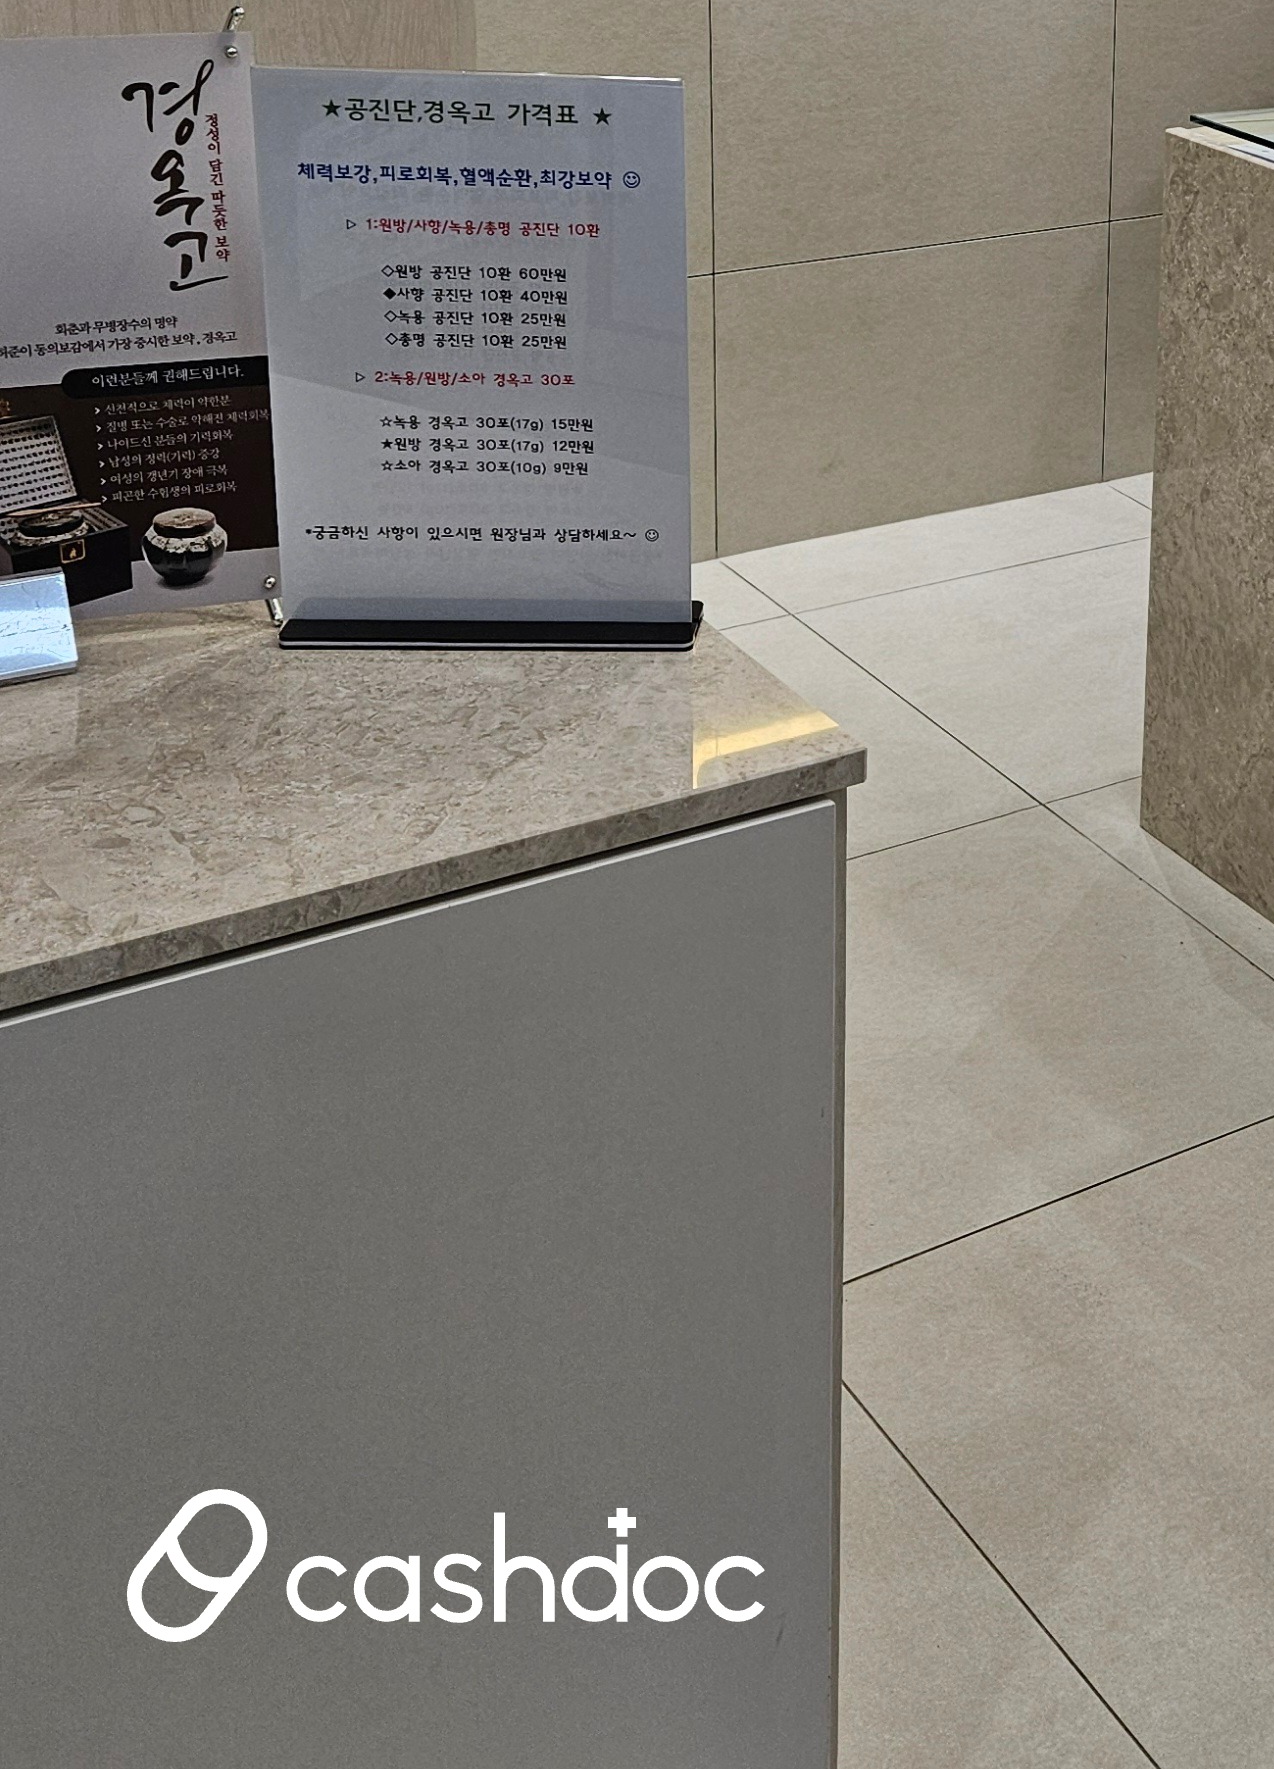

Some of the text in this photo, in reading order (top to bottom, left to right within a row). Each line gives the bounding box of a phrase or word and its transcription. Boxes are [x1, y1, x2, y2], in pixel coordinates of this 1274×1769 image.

[344, 98, 579, 127] 공진단,경옥고 가격표
[205, 113, 221, 155] 정성이
[121, 58, 229, 292] 경옥고
[209, 158, 224, 187] 담긴
[297, 161, 613, 190] 체력보강,피로회복,혈액순환,최강보약
[519, 221, 561, 238] 공진단
[568, 223, 601, 239] 10환
[215, 235, 230, 262] 보약
[394, 264, 567, 283] 원방 공진단 10환 60만원
[397, 287, 568, 305] 사향 공진단 10환 40만원
[154, 315, 178, 329] 명약
[397, 310, 567, 328] 녹용 공진단 10환 25만원
[34, 339, 107, 357] 동의보감에서
[108, 338, 132, 352] 가장
[133, 334, 171, 350] 중시한
[202, 330, 238, 345] 경옥고
[398, 332, 567, 350] 총명 공진단 10환 25만원
[91, 365, 245, 388] 이런분들께 권해드립니다.
[493, 372, 533, 387] 경옥고
[541, 374, 576, 386] 30포
[131, 419, 153, 430] 또는
[155, 416, 189, 429] 수술로
[428, 416, 469, 430] 경옥고
[476, 417, 544, 432] 30포(17g)
[552, 417, 594, 432] 15만원
[107, 435, 152, 451] 나이드신
[154, 432, 188, 447] 분들의
[428, 438, 469, 452] 경옥고
[476, 439, 545, 454] 30포(17g)
[552, 439, 595, 455] 12만원
[109, 454, 142, 468] 남성의
[428, 459, 469, 474] 경옥고
[476, 461, 547, 475] 30포(10g)
[553, 461, 588, 476] 9만원
[110, 464, 228, 485] 여성의 갱년기 장애 극복
[112, 489, 145, 502] 피곤한
[148, 484, 191, 500] 수험생의
[377, 526, 419, 541] 사항이
[427, 526, 483, 542] 있으시면
[490, 527, 547, 542] 원장님과
